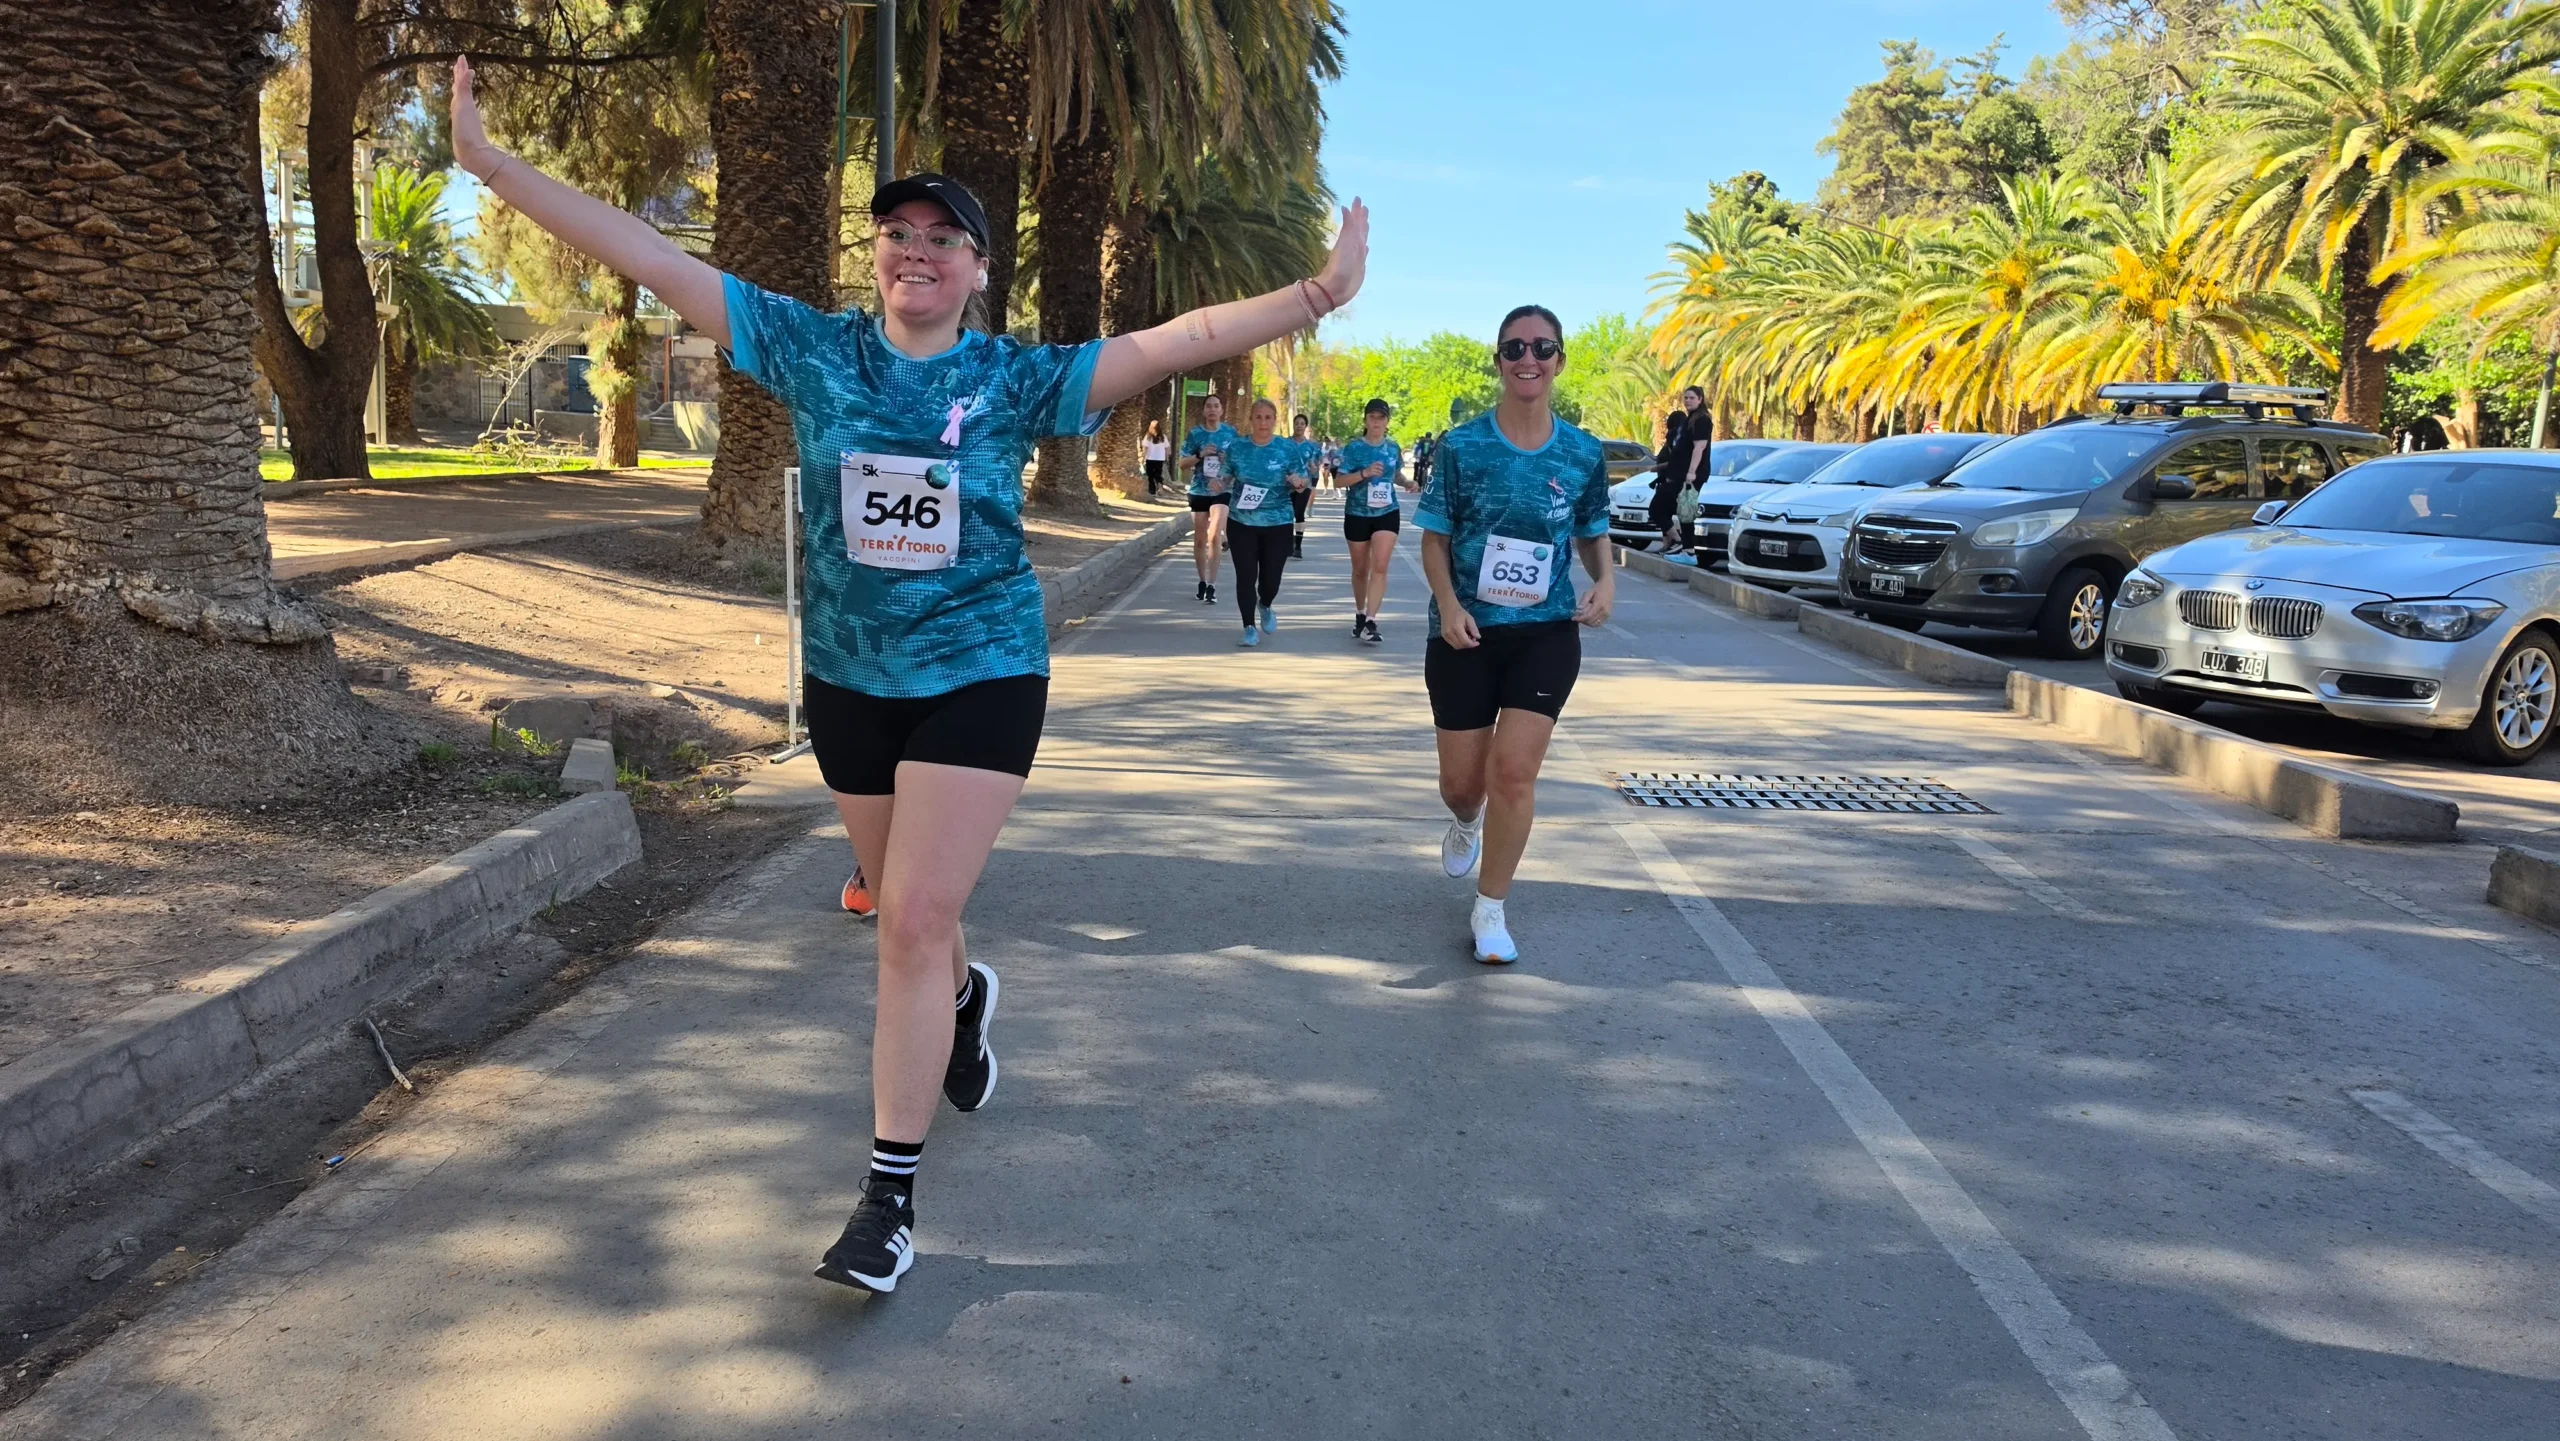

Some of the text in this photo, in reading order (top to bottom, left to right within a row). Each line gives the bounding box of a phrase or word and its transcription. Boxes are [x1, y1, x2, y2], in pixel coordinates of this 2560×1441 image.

[862, 464, 879, 477] 5k
[1244, 494, 1262, 502] 603
[1372, 491, 1388, 499] 655
[862, 491, 941, 529] 546
[860, 535, 946, 554] TERRITORIO
[1492, 560, 1540, 585] 653
[1488, 586, 1540, 600] TERRITORIO
[1889, 580, 1903, 592] 441
[2202, 652, 2264, 676] LUX 348
